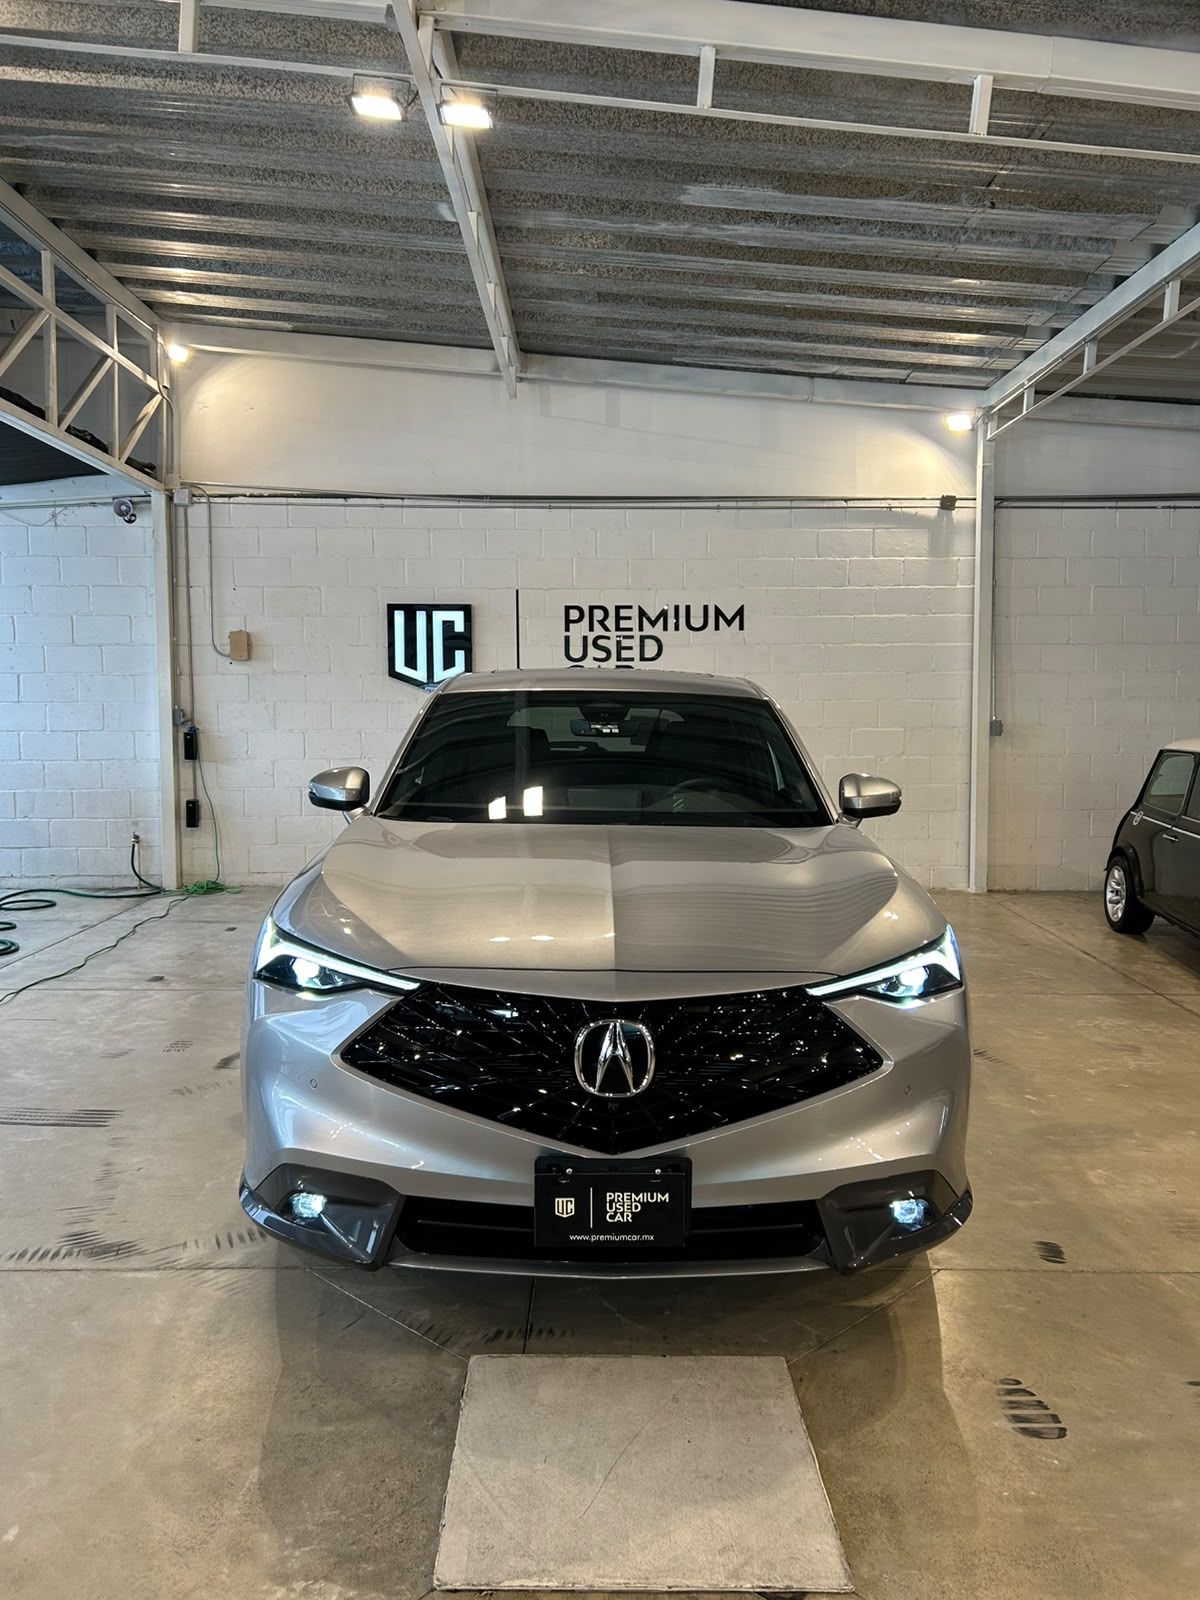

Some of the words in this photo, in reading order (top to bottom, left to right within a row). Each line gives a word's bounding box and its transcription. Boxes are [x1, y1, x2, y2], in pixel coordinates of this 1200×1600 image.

[564, 604, 745, 632] PREMIUM
[564, 635, 663, 662] USED
[606, 1192, 669, 1202] PREMIUM
[606, 1203, 641, 1212] USED
[606, 1213, 632, 1222] CAR
[569, 1233, 654, 1242] www.premiumcar.mx
